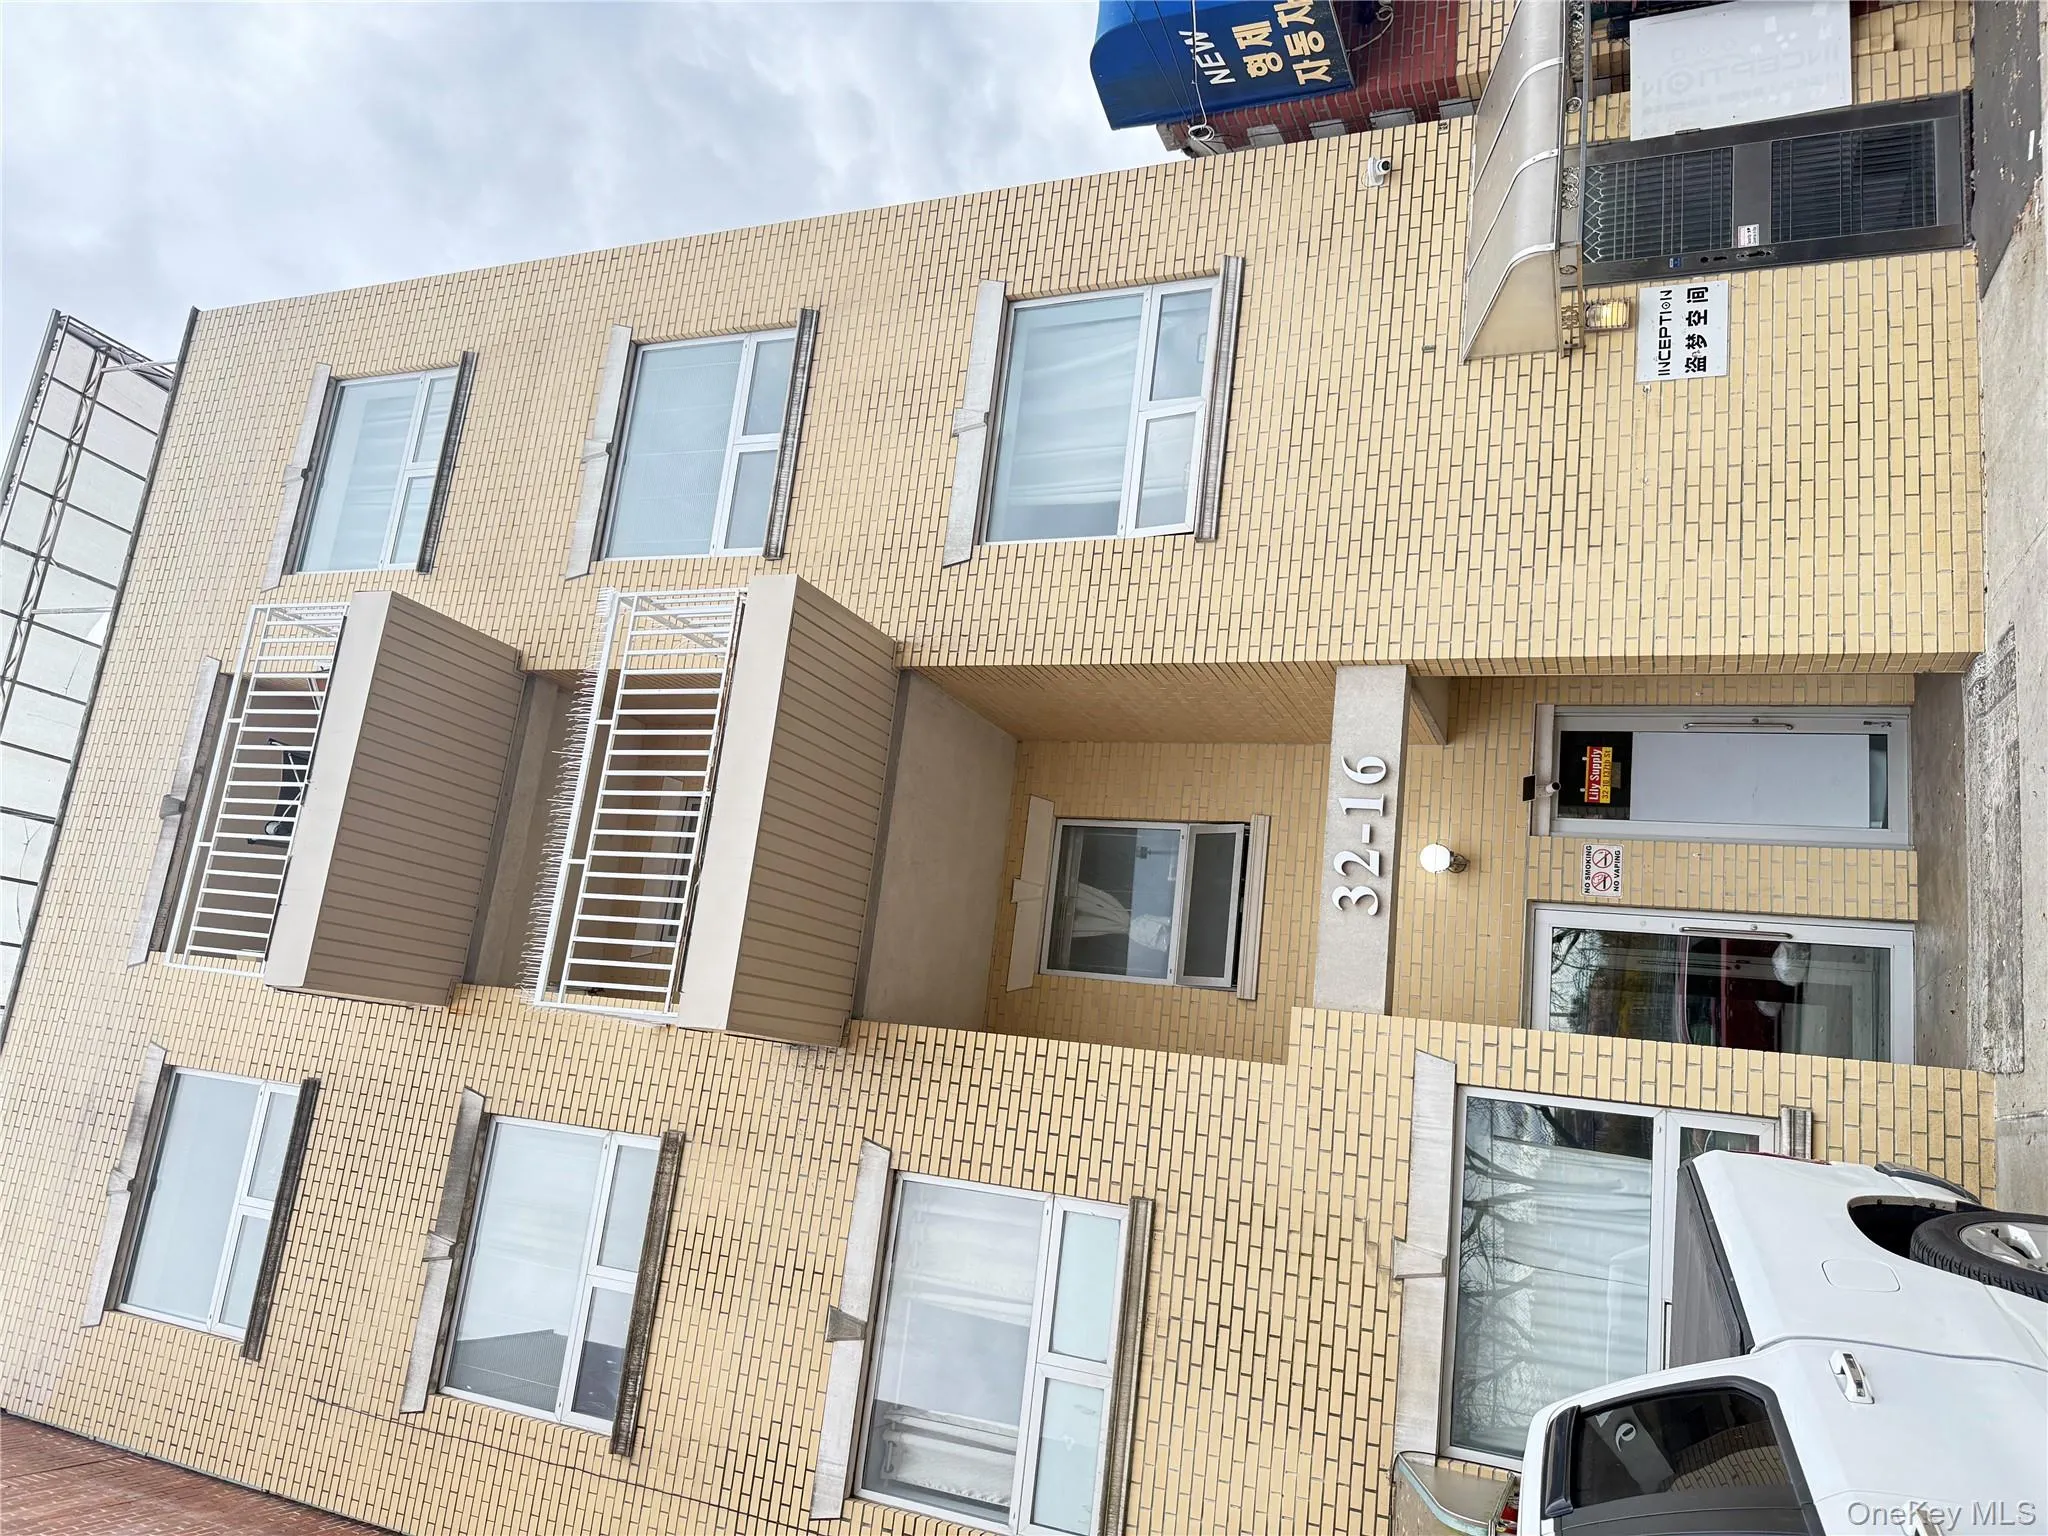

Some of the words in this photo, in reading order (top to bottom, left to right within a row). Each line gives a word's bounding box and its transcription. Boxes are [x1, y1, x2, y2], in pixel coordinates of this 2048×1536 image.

[1179, 31, 1236, 85] NEW
[1231, 20, 1284, 78] 형제
[1658, 290, 1672, 376] INCEPTION
[1684, 286, 1709, 373] 盗梦空间
[1590, 749, 1602, 781] Supply
[1603, 750, 1611, 758] St
[1589, 783, 1601, 800] Lily
[1332, 755, 1387, 916] 32-16
[1584, 882, 1591, 893] NO
[1613, 880, 1620, 891] NO
